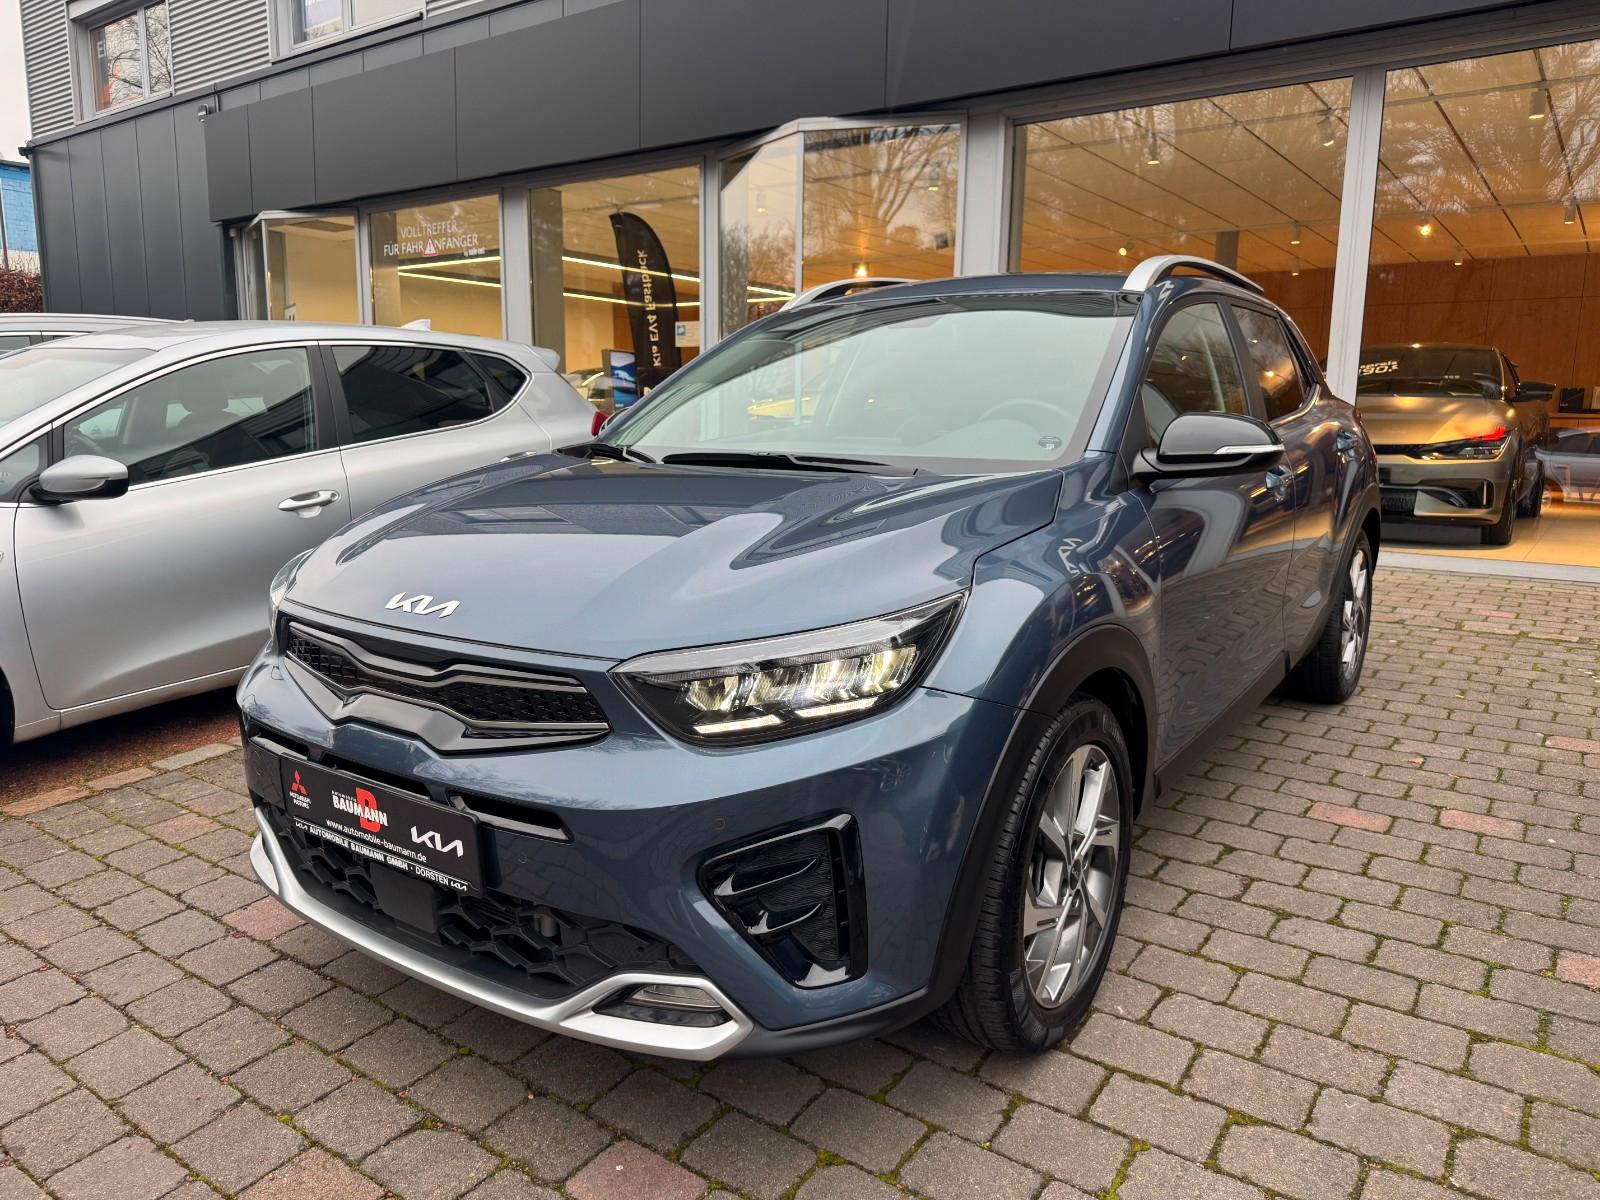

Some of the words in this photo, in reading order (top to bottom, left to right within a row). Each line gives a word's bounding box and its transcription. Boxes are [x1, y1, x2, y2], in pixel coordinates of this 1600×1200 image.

[384, 591, 461, 618] KIA
[332, 794, 388, 827] BAUMANN
[309, 826, 349, 849] AUTOMOBILE
[350, 842, 385, 862] BAUMANN
[386, 855, 409, 870] GMBH
[415, 866, 449, 886] DORSTEN
[326, 818, 427, 863] www.automobile-baumann.de
[410, 825, 464, 858] KIA
